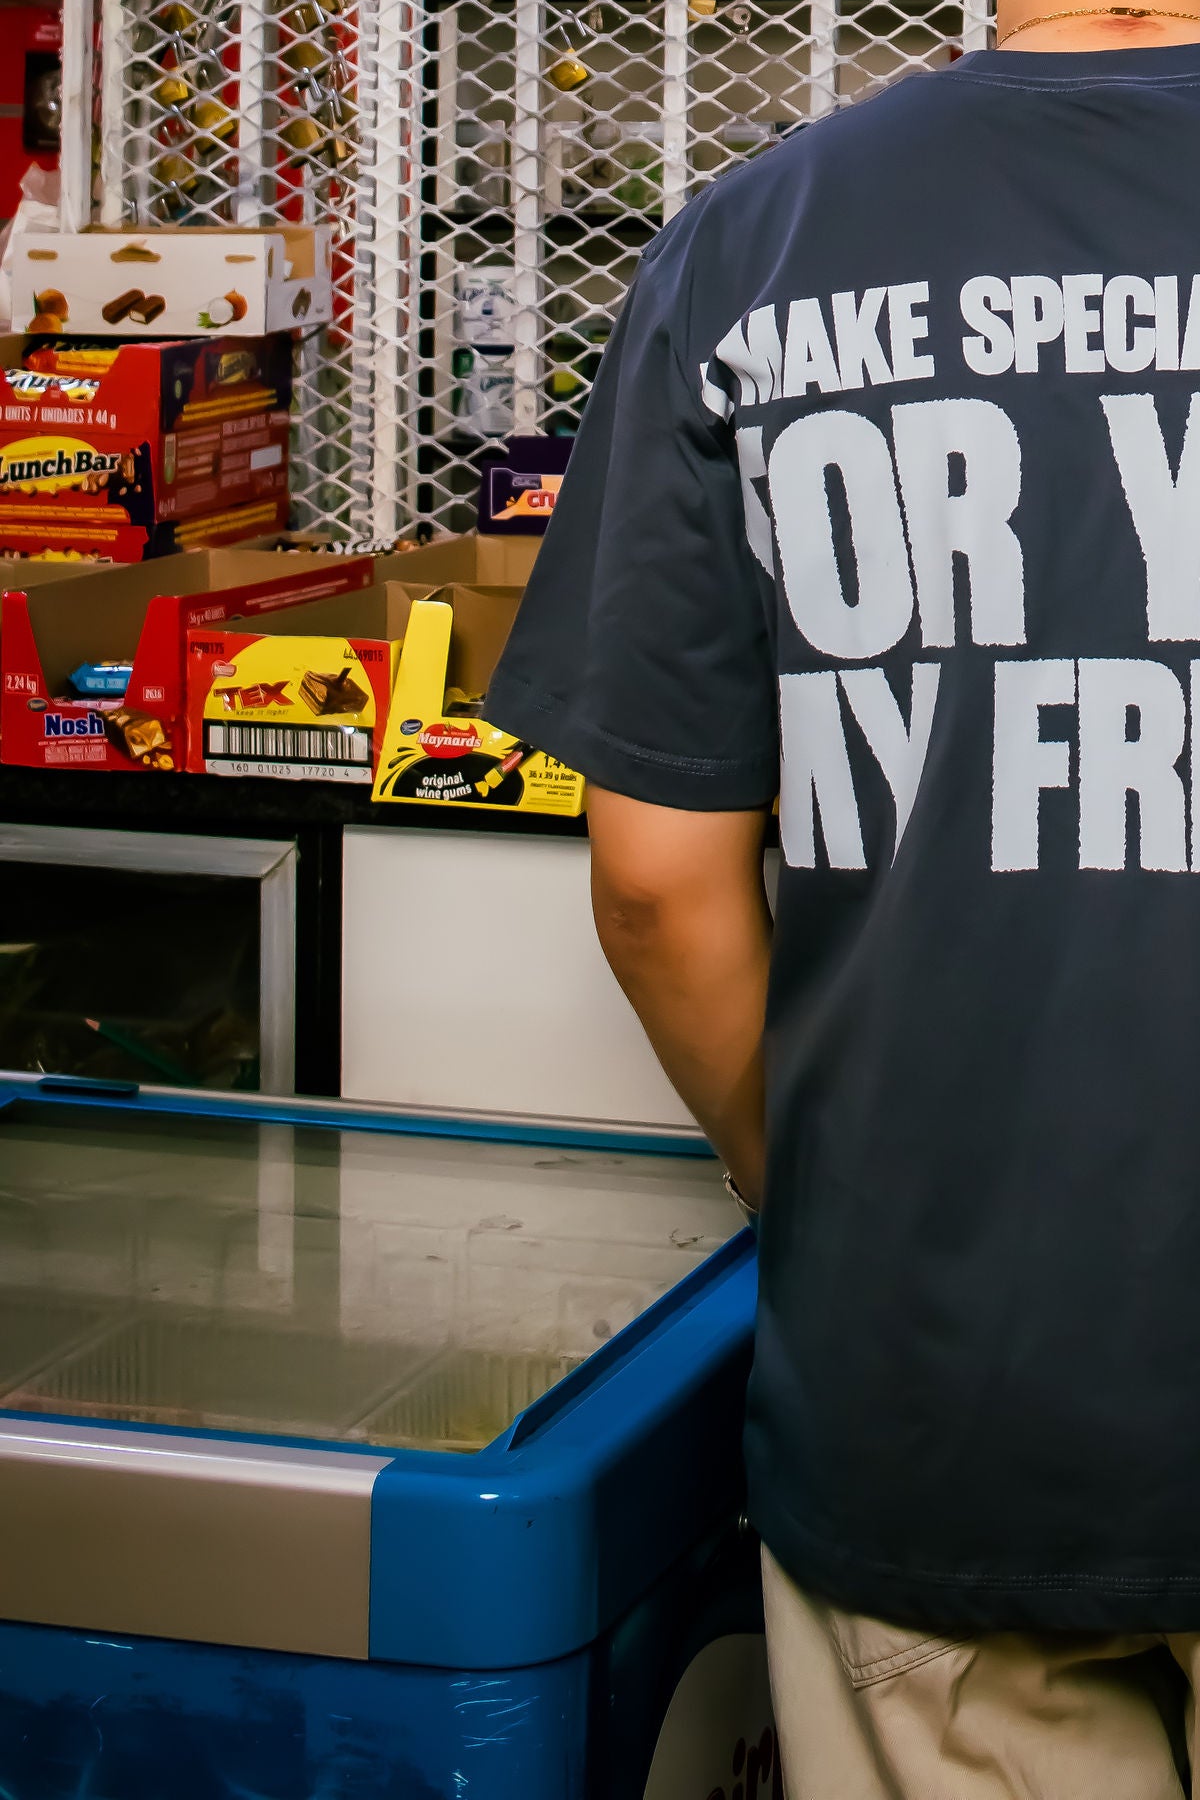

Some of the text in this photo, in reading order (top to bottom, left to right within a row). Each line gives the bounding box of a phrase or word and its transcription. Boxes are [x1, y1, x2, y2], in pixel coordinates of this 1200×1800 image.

[715, 280, 936, 406] MAKE
[5, 405, 31, 422] UNITS
[41, 406, 85, 425] UNIDADES
[87, 409, 94, 425] X
[95, 409, 108, 425] 44
[6, 674, 37, 694] 2.24 kg
[212, 680, 296, 712] TEX
[44, 712, 105, 738] Nosh
[416, 731, 483, 749] Maynards
[230, 762, 249, 773] 160
[301, 766, 335, 777] 17720
[422, 771, 465, 788] original
[415, 784, 473, 801] wine gums
